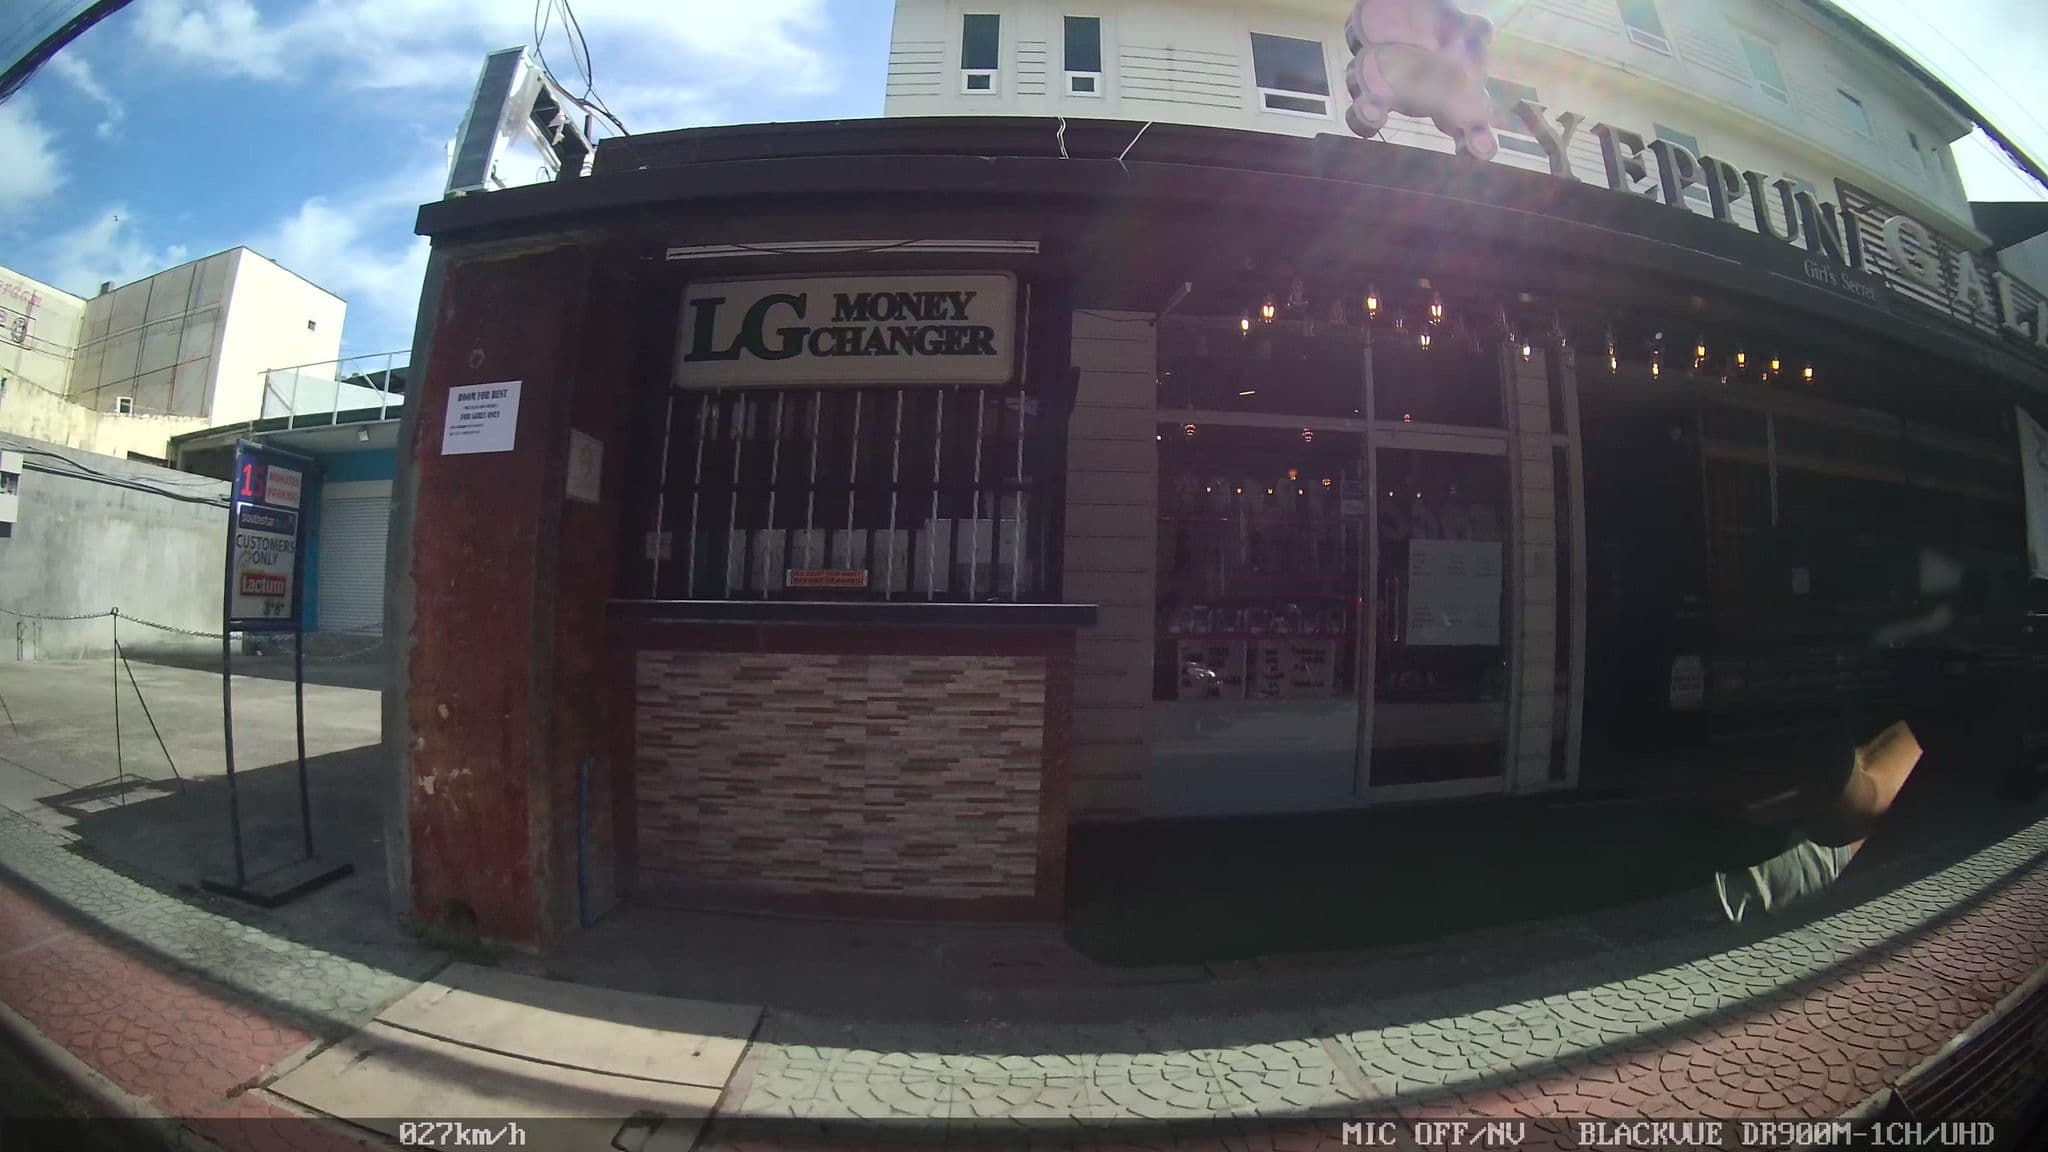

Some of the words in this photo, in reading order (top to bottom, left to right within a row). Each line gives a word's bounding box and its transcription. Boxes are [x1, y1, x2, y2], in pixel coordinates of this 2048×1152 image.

[1513, 98, 1872, 273] YEPPUNI
[1804, 258, 1838, 287] Girl's
[1841, 272, 1876, 302] Secret
[832, 290, 976, 322] MONEY
[684, 292, 808, 362] LG
[808, 325, 998, 358] CHANGER
[477, 391, 490, 400] FOR
[236, 533, 296, 554] CUSTOMERS
[252, 550, 279, 566] ONLY
[242, 575, 285, 594] Lactum
